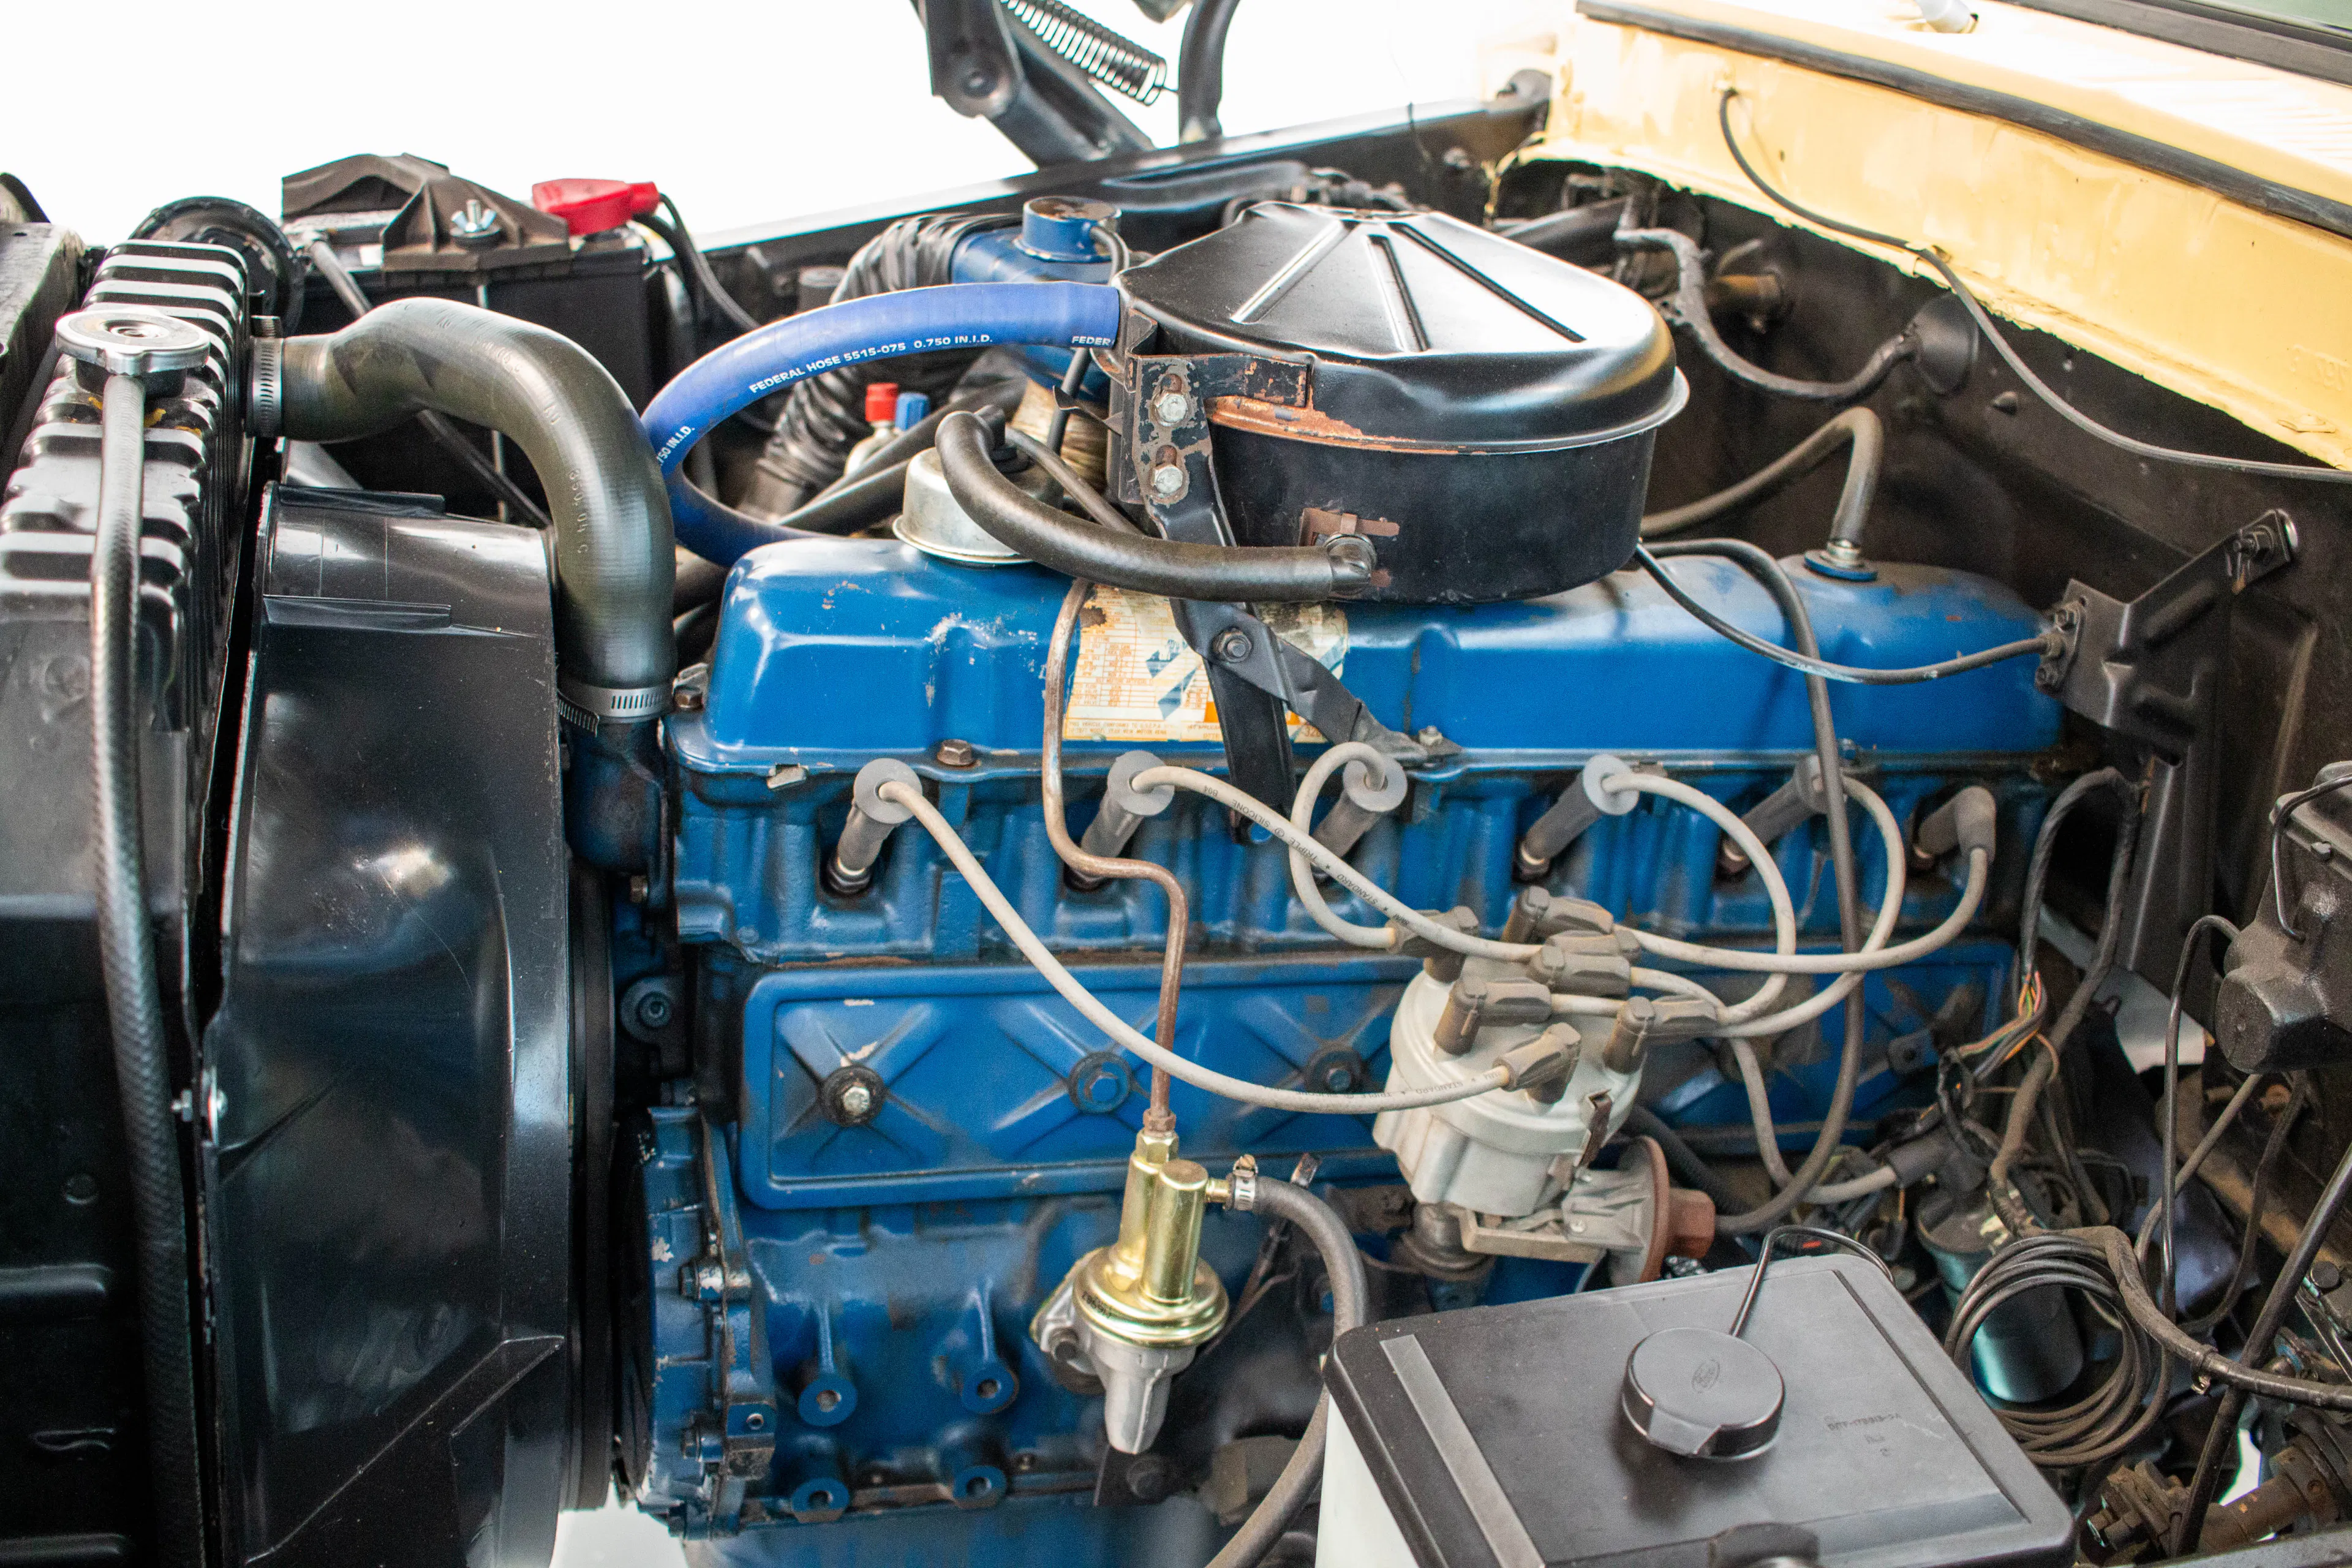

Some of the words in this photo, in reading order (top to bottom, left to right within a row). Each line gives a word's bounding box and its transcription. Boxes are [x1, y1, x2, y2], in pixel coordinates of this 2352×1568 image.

[749, 368, 806, 393] FEDERAL
[806, 355, 841, 372] HOSE
[844, 342, 906, 362] 5515-075
[914, 336, 951, 349] 0.750
[954, 334, 993, 344] IN.I.D.
[1204, 785, 1219, 797] B04
[1231, 799, 1271, 827] SILICONE
[1287, 837, 1318, 862] TRIPLE
[1336, 873, 1378, 905] STANDARD
